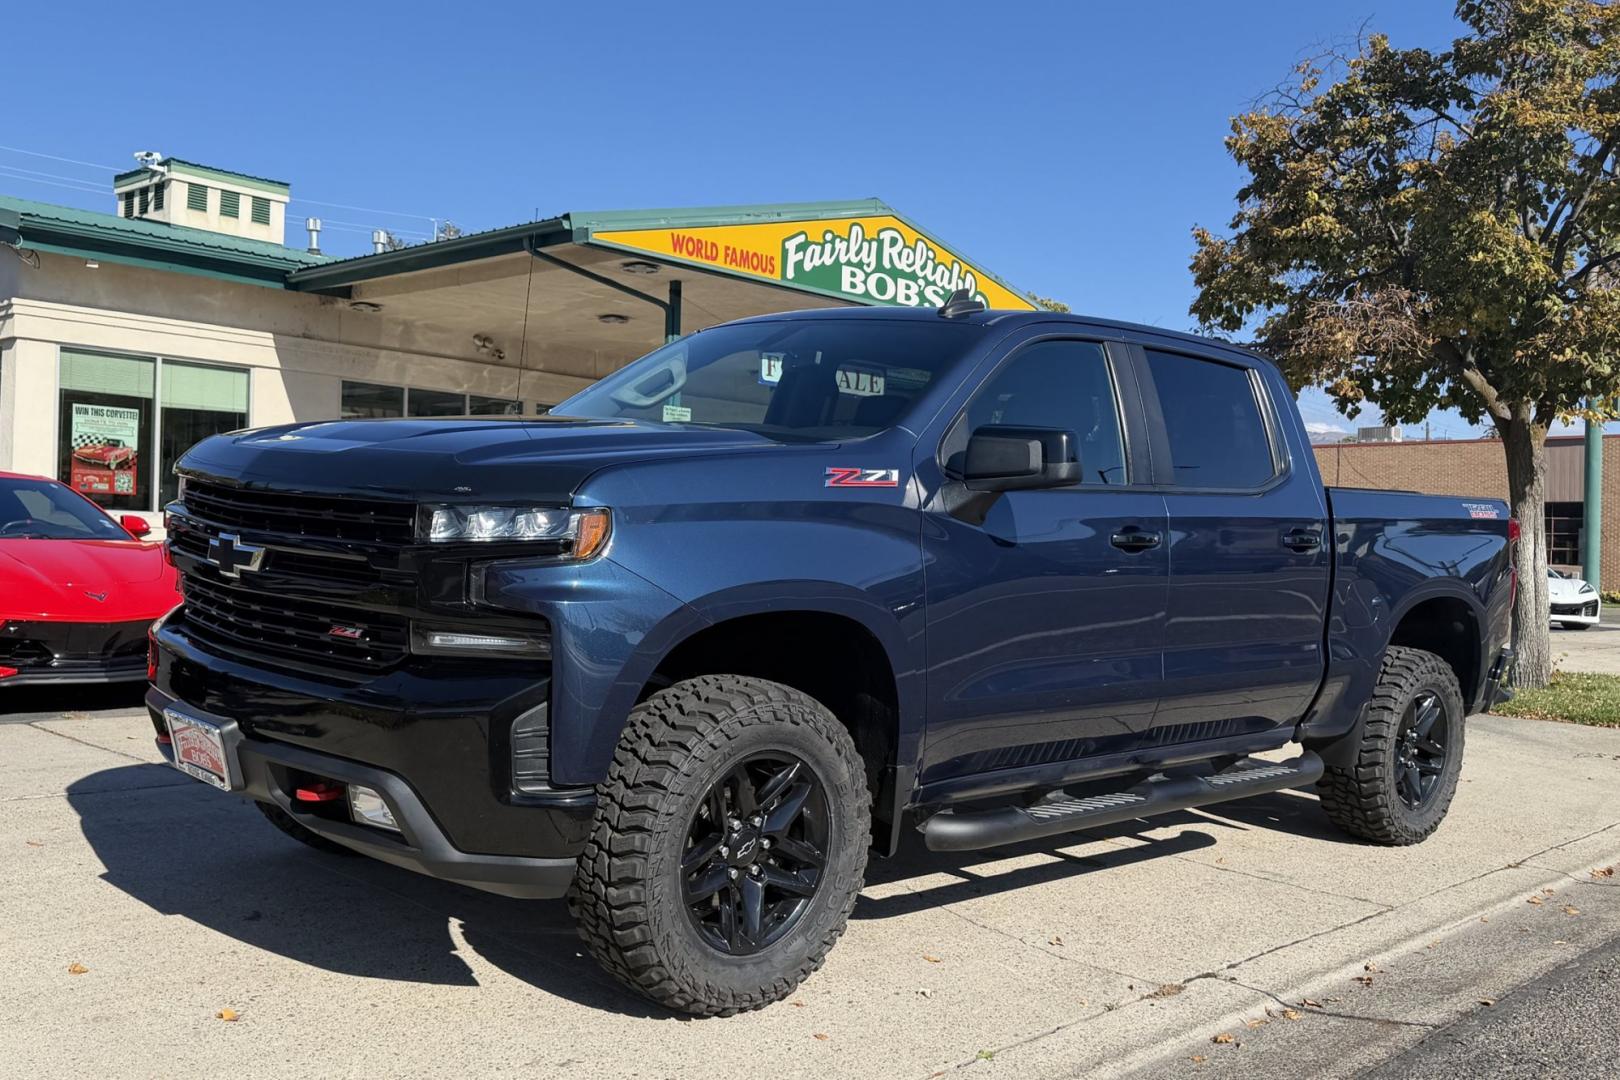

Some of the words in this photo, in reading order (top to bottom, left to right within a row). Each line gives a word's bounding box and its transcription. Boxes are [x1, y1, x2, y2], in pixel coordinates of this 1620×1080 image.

[671, 232, 718, 261] WORLD
[724, 245, 775, 275] FAMOUS
[785, 225, 877, 279] Fairly
[880, 229, 986, 308] Reliabl
[841, 265, 945, 308] BOB'S
[839, 369, 882, 393] ALE
[75, 406, 89, 415] WIN
[91, 407, 104, 417] THIS
[823, 467, 899, 487] Z71
